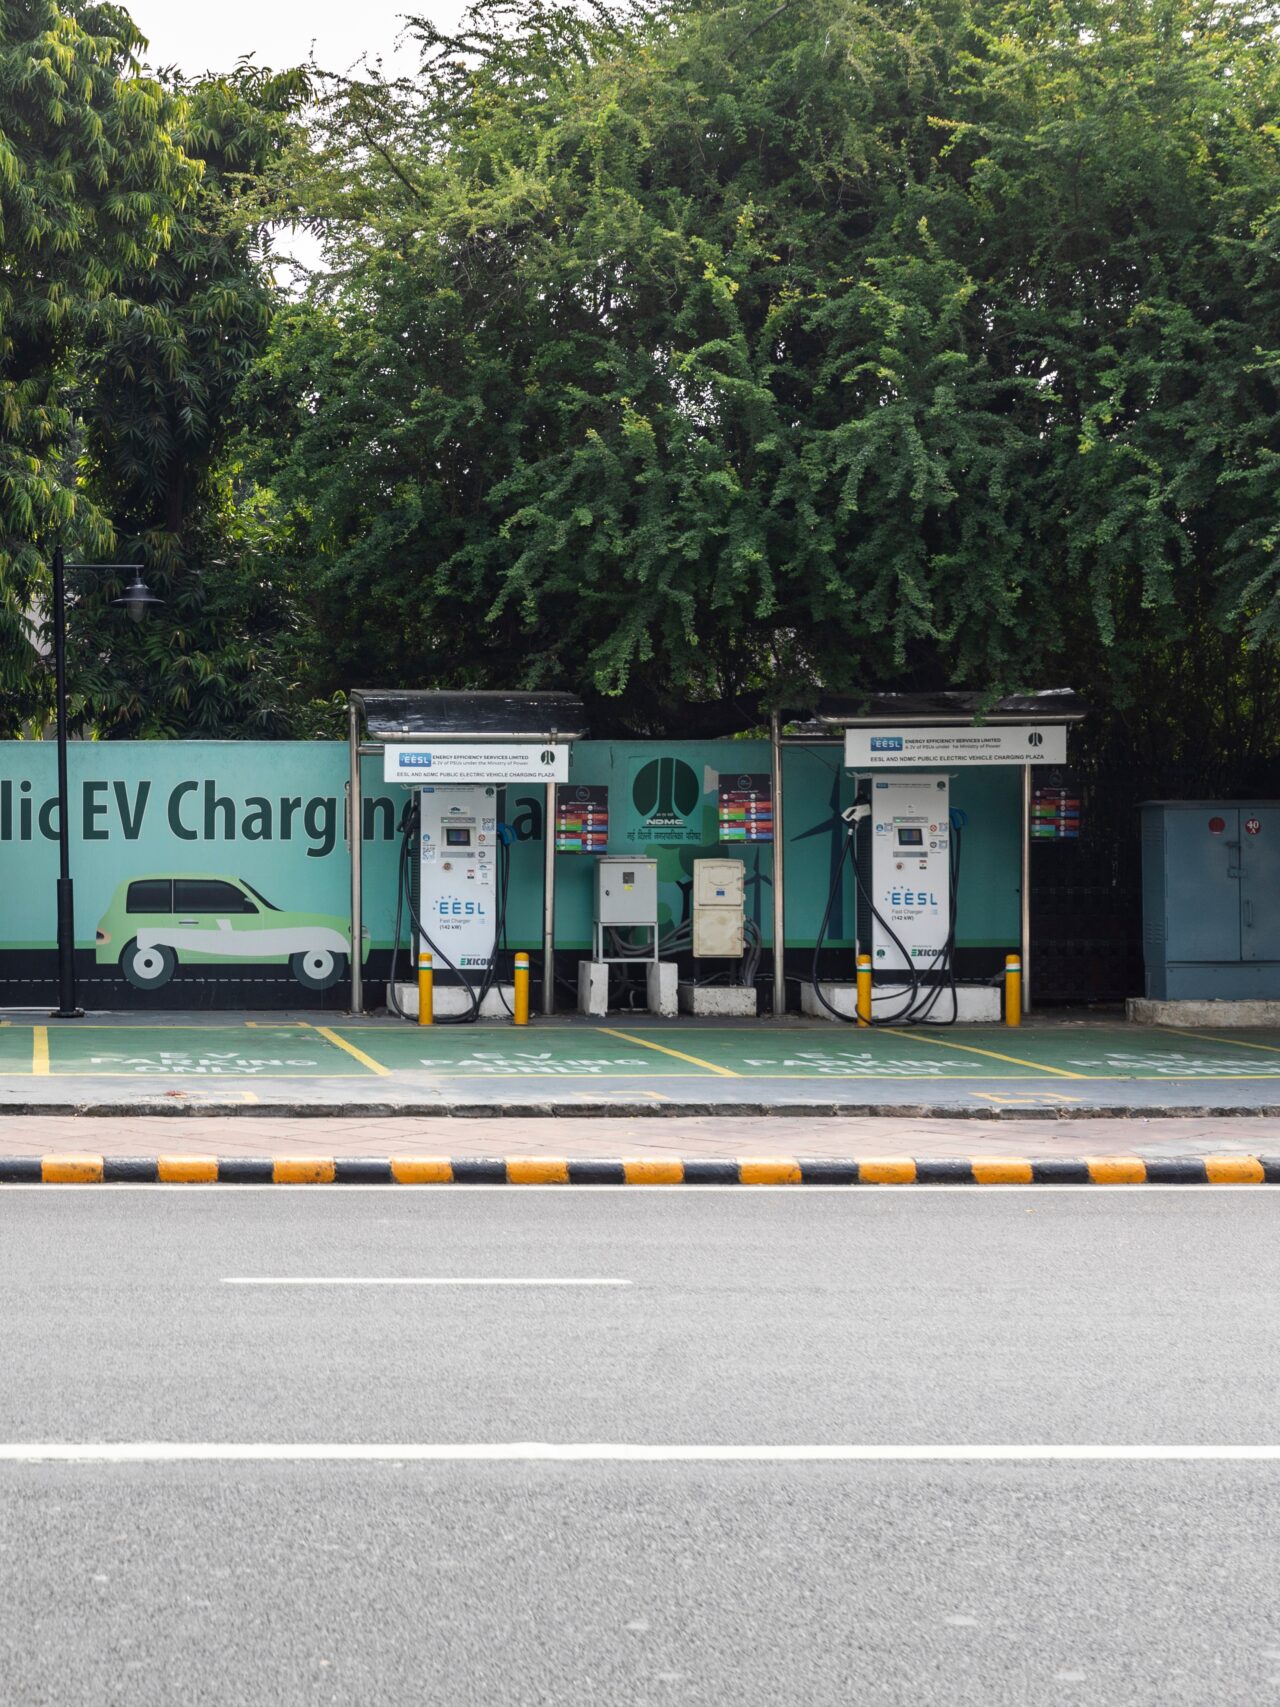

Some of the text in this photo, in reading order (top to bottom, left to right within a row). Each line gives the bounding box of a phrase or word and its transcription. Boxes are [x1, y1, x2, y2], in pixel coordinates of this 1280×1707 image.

[875, 740, 900, 748] EESL
[405, 756, 429, 764] EESL
[82, 780, 150, 841] EV
[1247, 820, 1259, 829] 40
[892, 893, 938, 905] EESL
[440, 902, 485, 914] EESL
